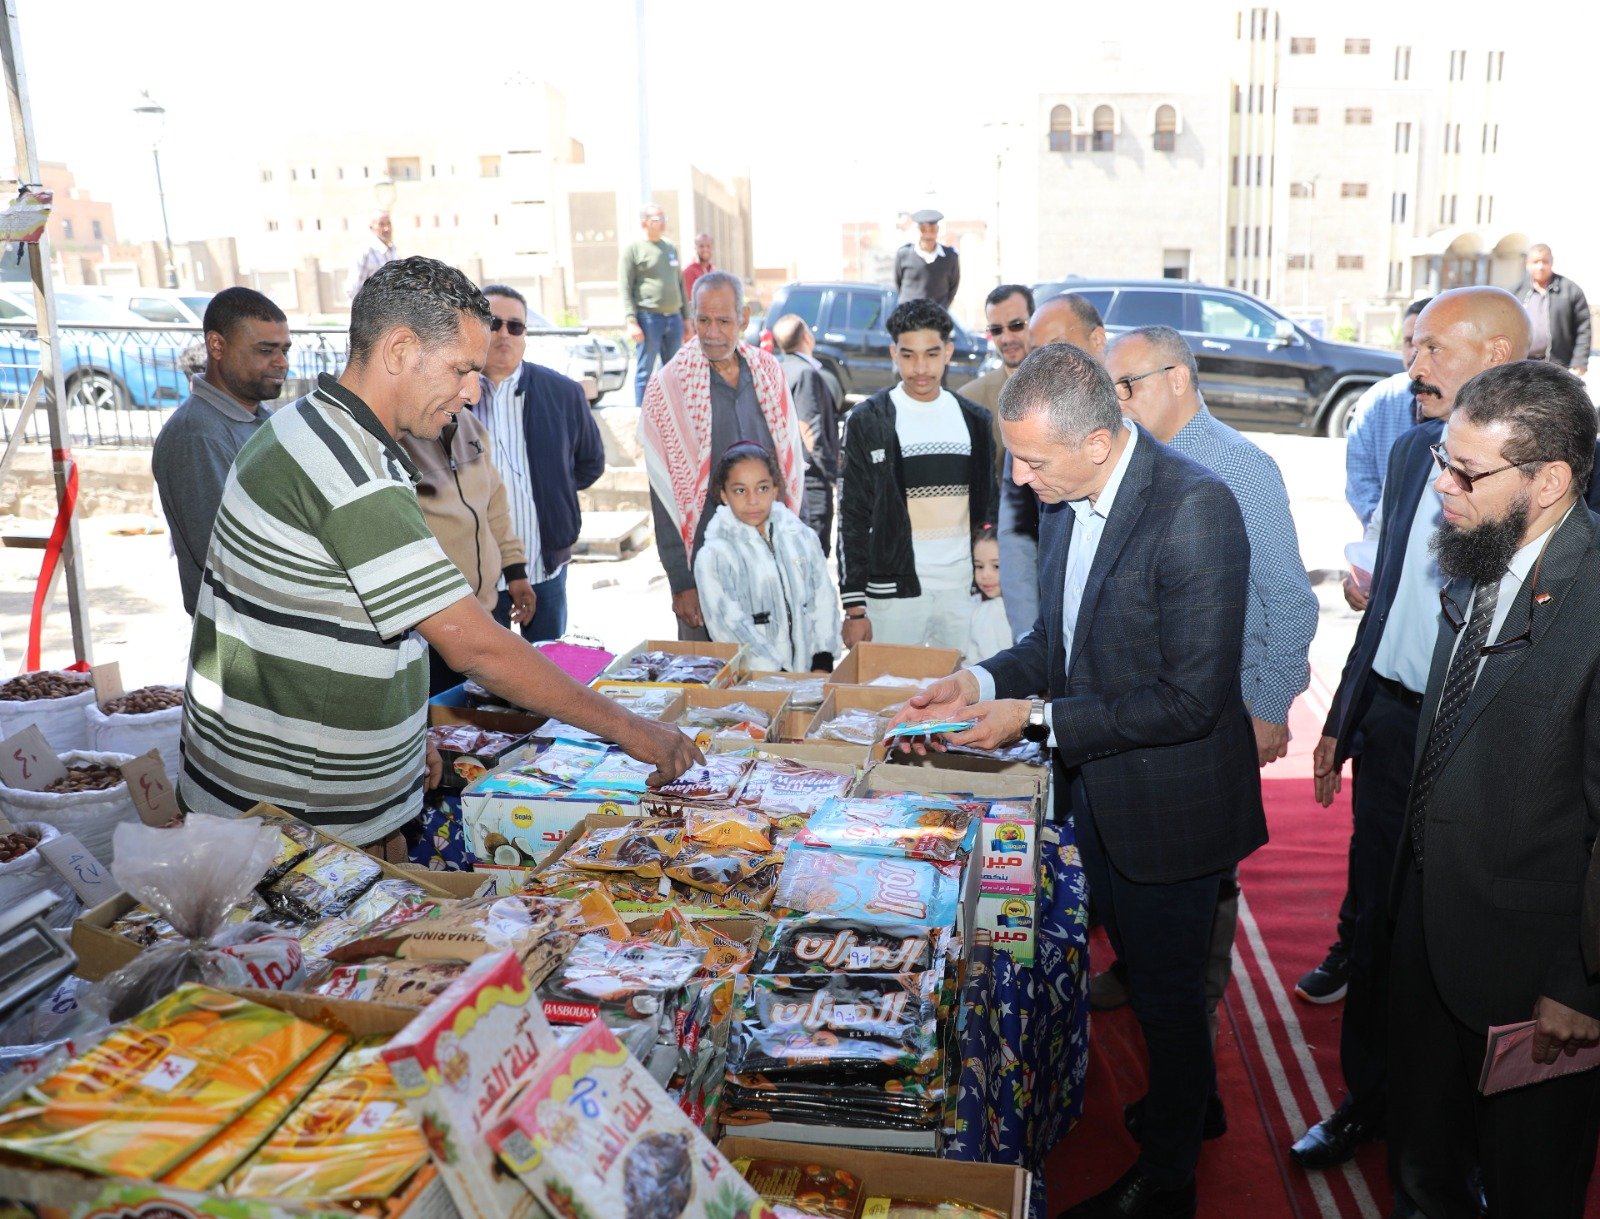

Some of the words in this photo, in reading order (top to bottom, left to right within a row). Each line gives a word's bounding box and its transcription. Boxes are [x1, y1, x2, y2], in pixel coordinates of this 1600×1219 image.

[412, 933, 486, 943] TAMARIND
[794, 929, 928, 974] المزان
[544, 1003, 598, 1020] BASBOUSA
[769, 988, 911, 1030] المزان
[504, 1030, 540, 1080] ليلة
[472, 1062, 511, 1134] القدر
[613, 1086, 653, 1133] ليلة
